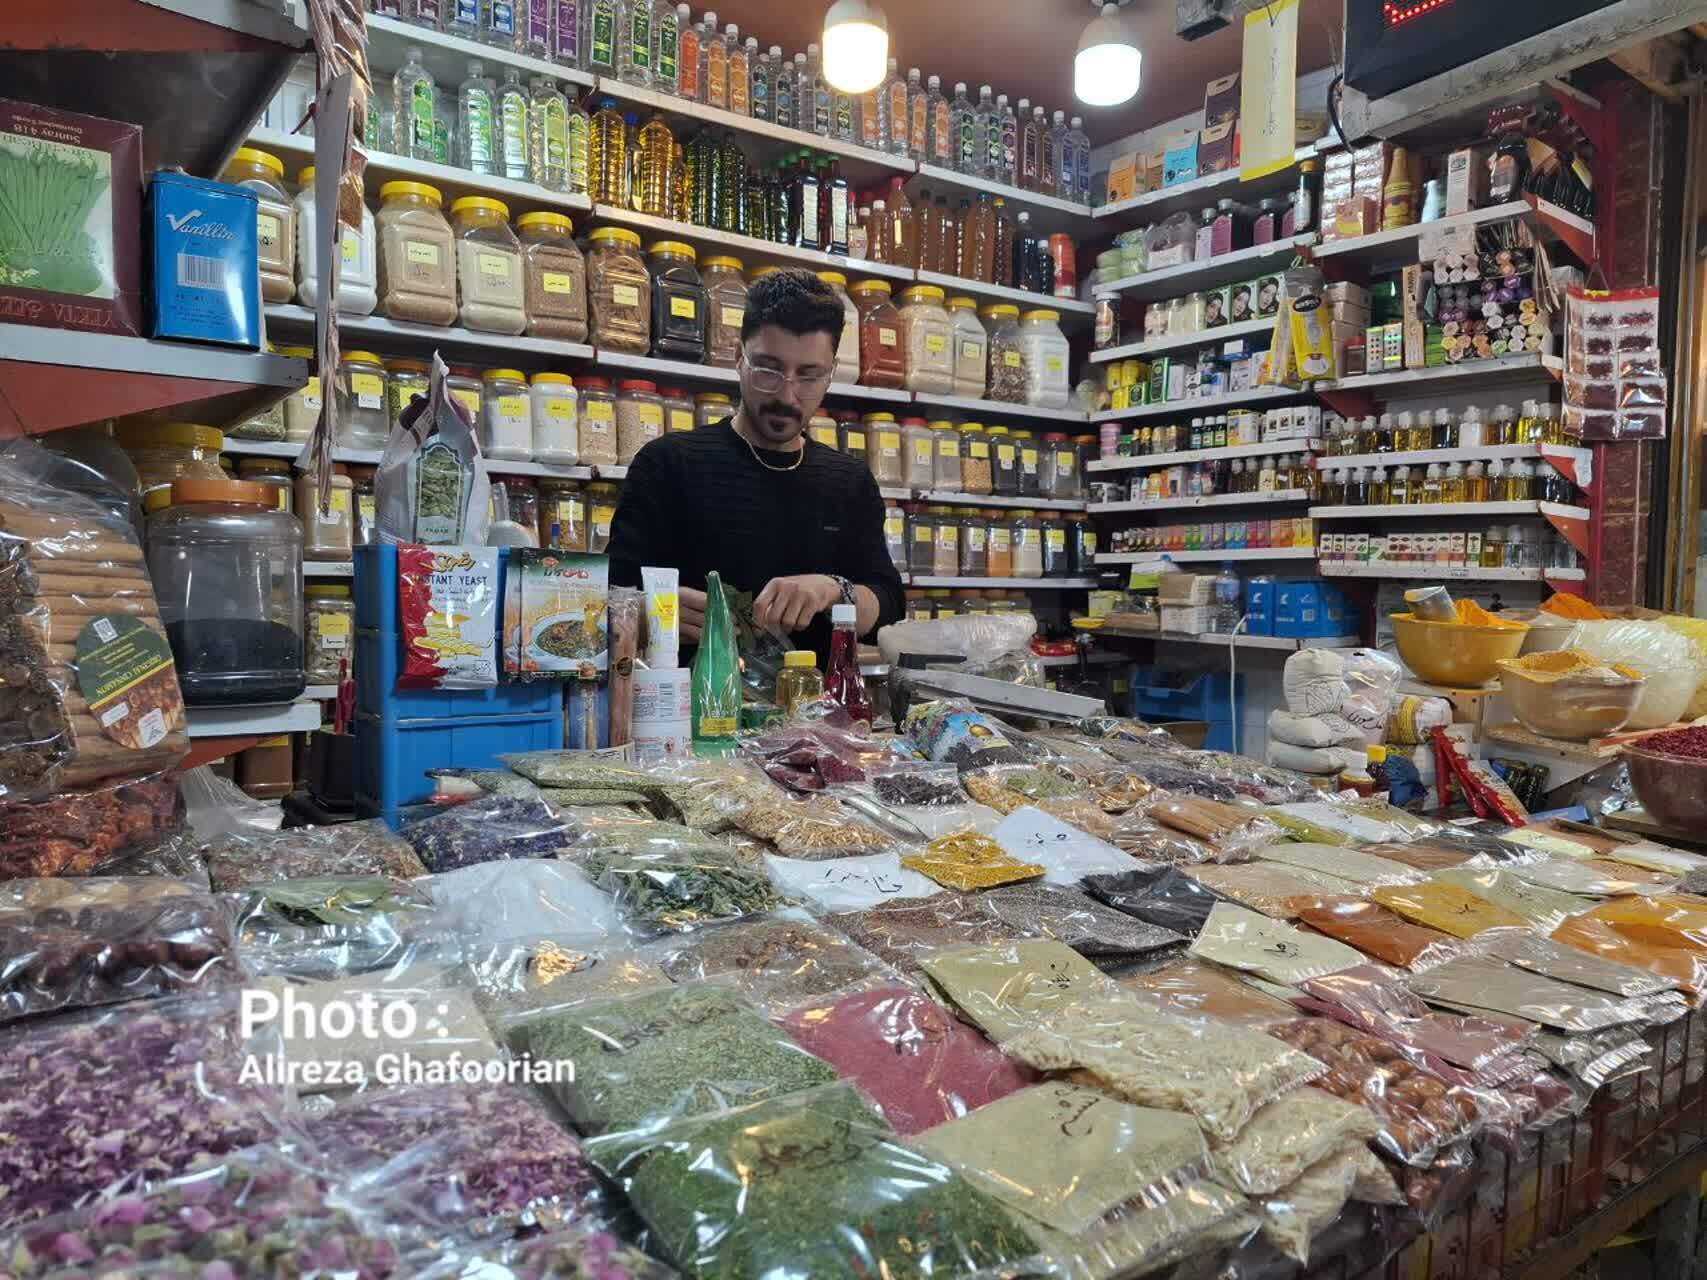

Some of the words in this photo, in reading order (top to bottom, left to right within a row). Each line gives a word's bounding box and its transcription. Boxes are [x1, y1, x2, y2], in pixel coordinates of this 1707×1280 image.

[41, 128, 81, 144] Sunray
[166, 209, 238, 240] Vanillin
[459, 575, 487, 586] YEAST
